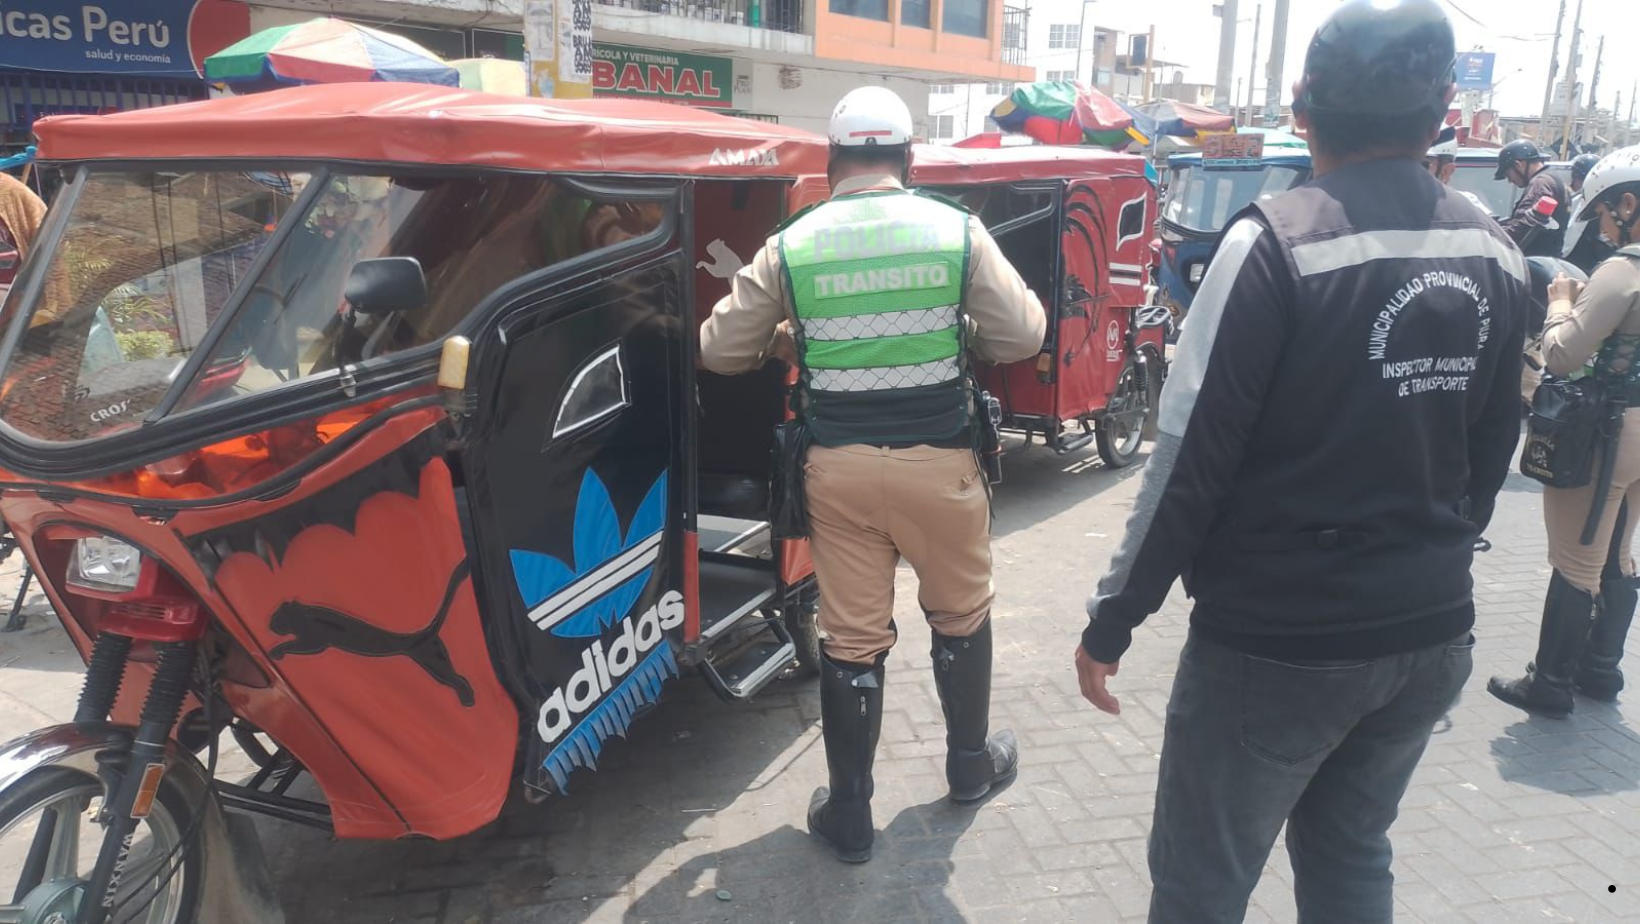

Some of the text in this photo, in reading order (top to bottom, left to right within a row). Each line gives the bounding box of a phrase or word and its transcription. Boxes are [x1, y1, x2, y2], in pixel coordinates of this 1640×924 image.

[82, 5, 170, 48] Perú
[85, 50, 113, 60] salud
[115, 52, 122, 62] y
[623, 50, 630, 60] Y
[631, 52, 679, 66] VETERINARIA
[814, 219, 941, 263] POLICIA
[815, 264, 948, 296] TRANSITO
[1368, 278, 1424, 360] MUNICIPALIDAD
[1423, 271, 1481, 301] PROVINCIAL
[1477, 297, 1489, 316] DE
[1382, 357, 1433, 378] INSPECTOR
[1398, 376, 1469, 397] DE TRANSPORTE
[90, 399, 131, 422] CROS
[537, 590, 685, 743] adidas
[102, 833, 135, 907] WANXIN
